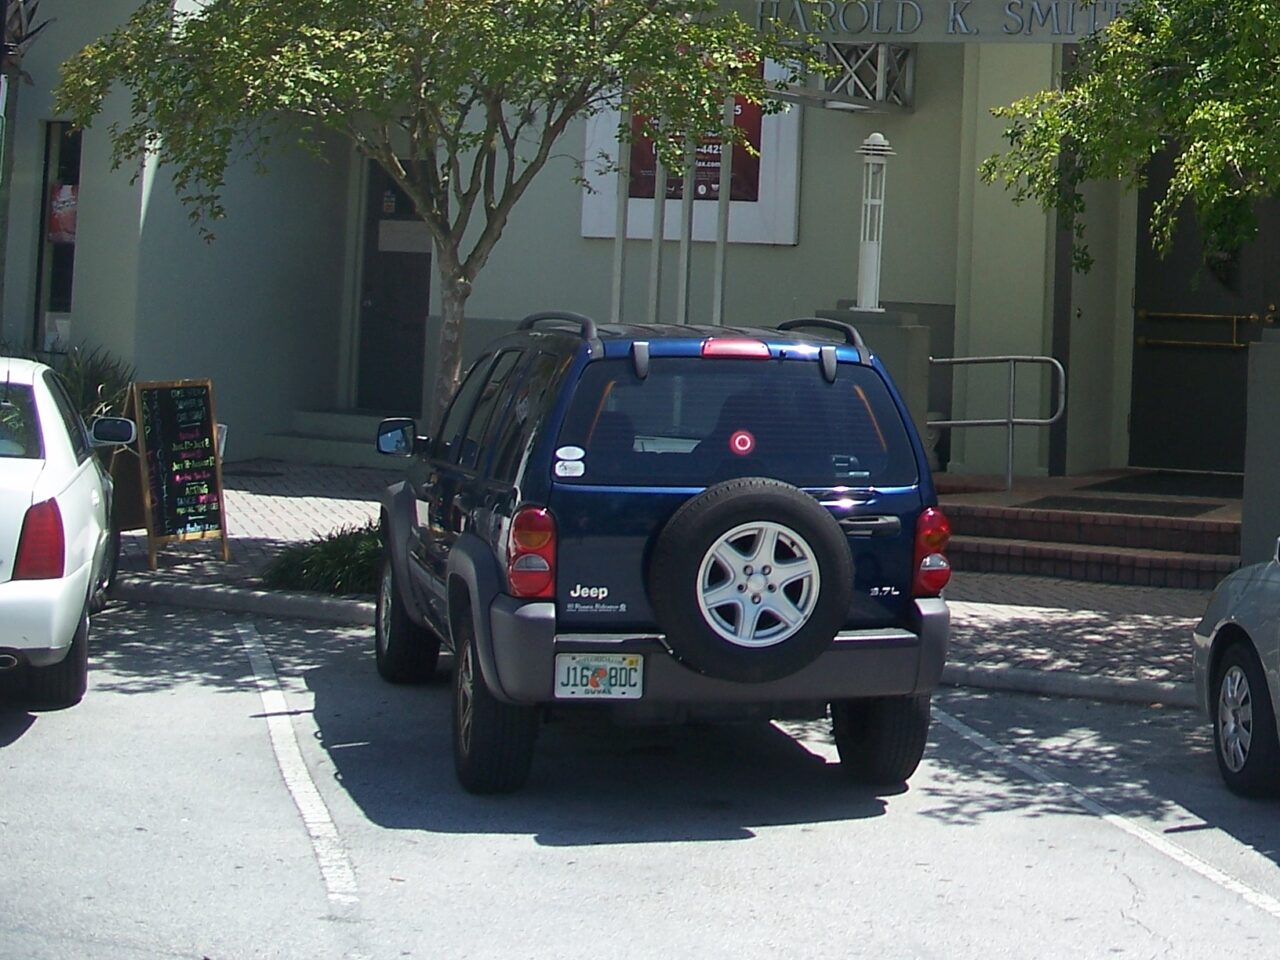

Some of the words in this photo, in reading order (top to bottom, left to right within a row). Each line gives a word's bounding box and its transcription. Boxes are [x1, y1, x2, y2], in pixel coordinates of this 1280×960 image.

[755, 0, 923, 35] HAROLD
[948, 0, 979, 35] K.
[570, 584, 609, 600] Jeep
[560, 666, 590, 687] J16
